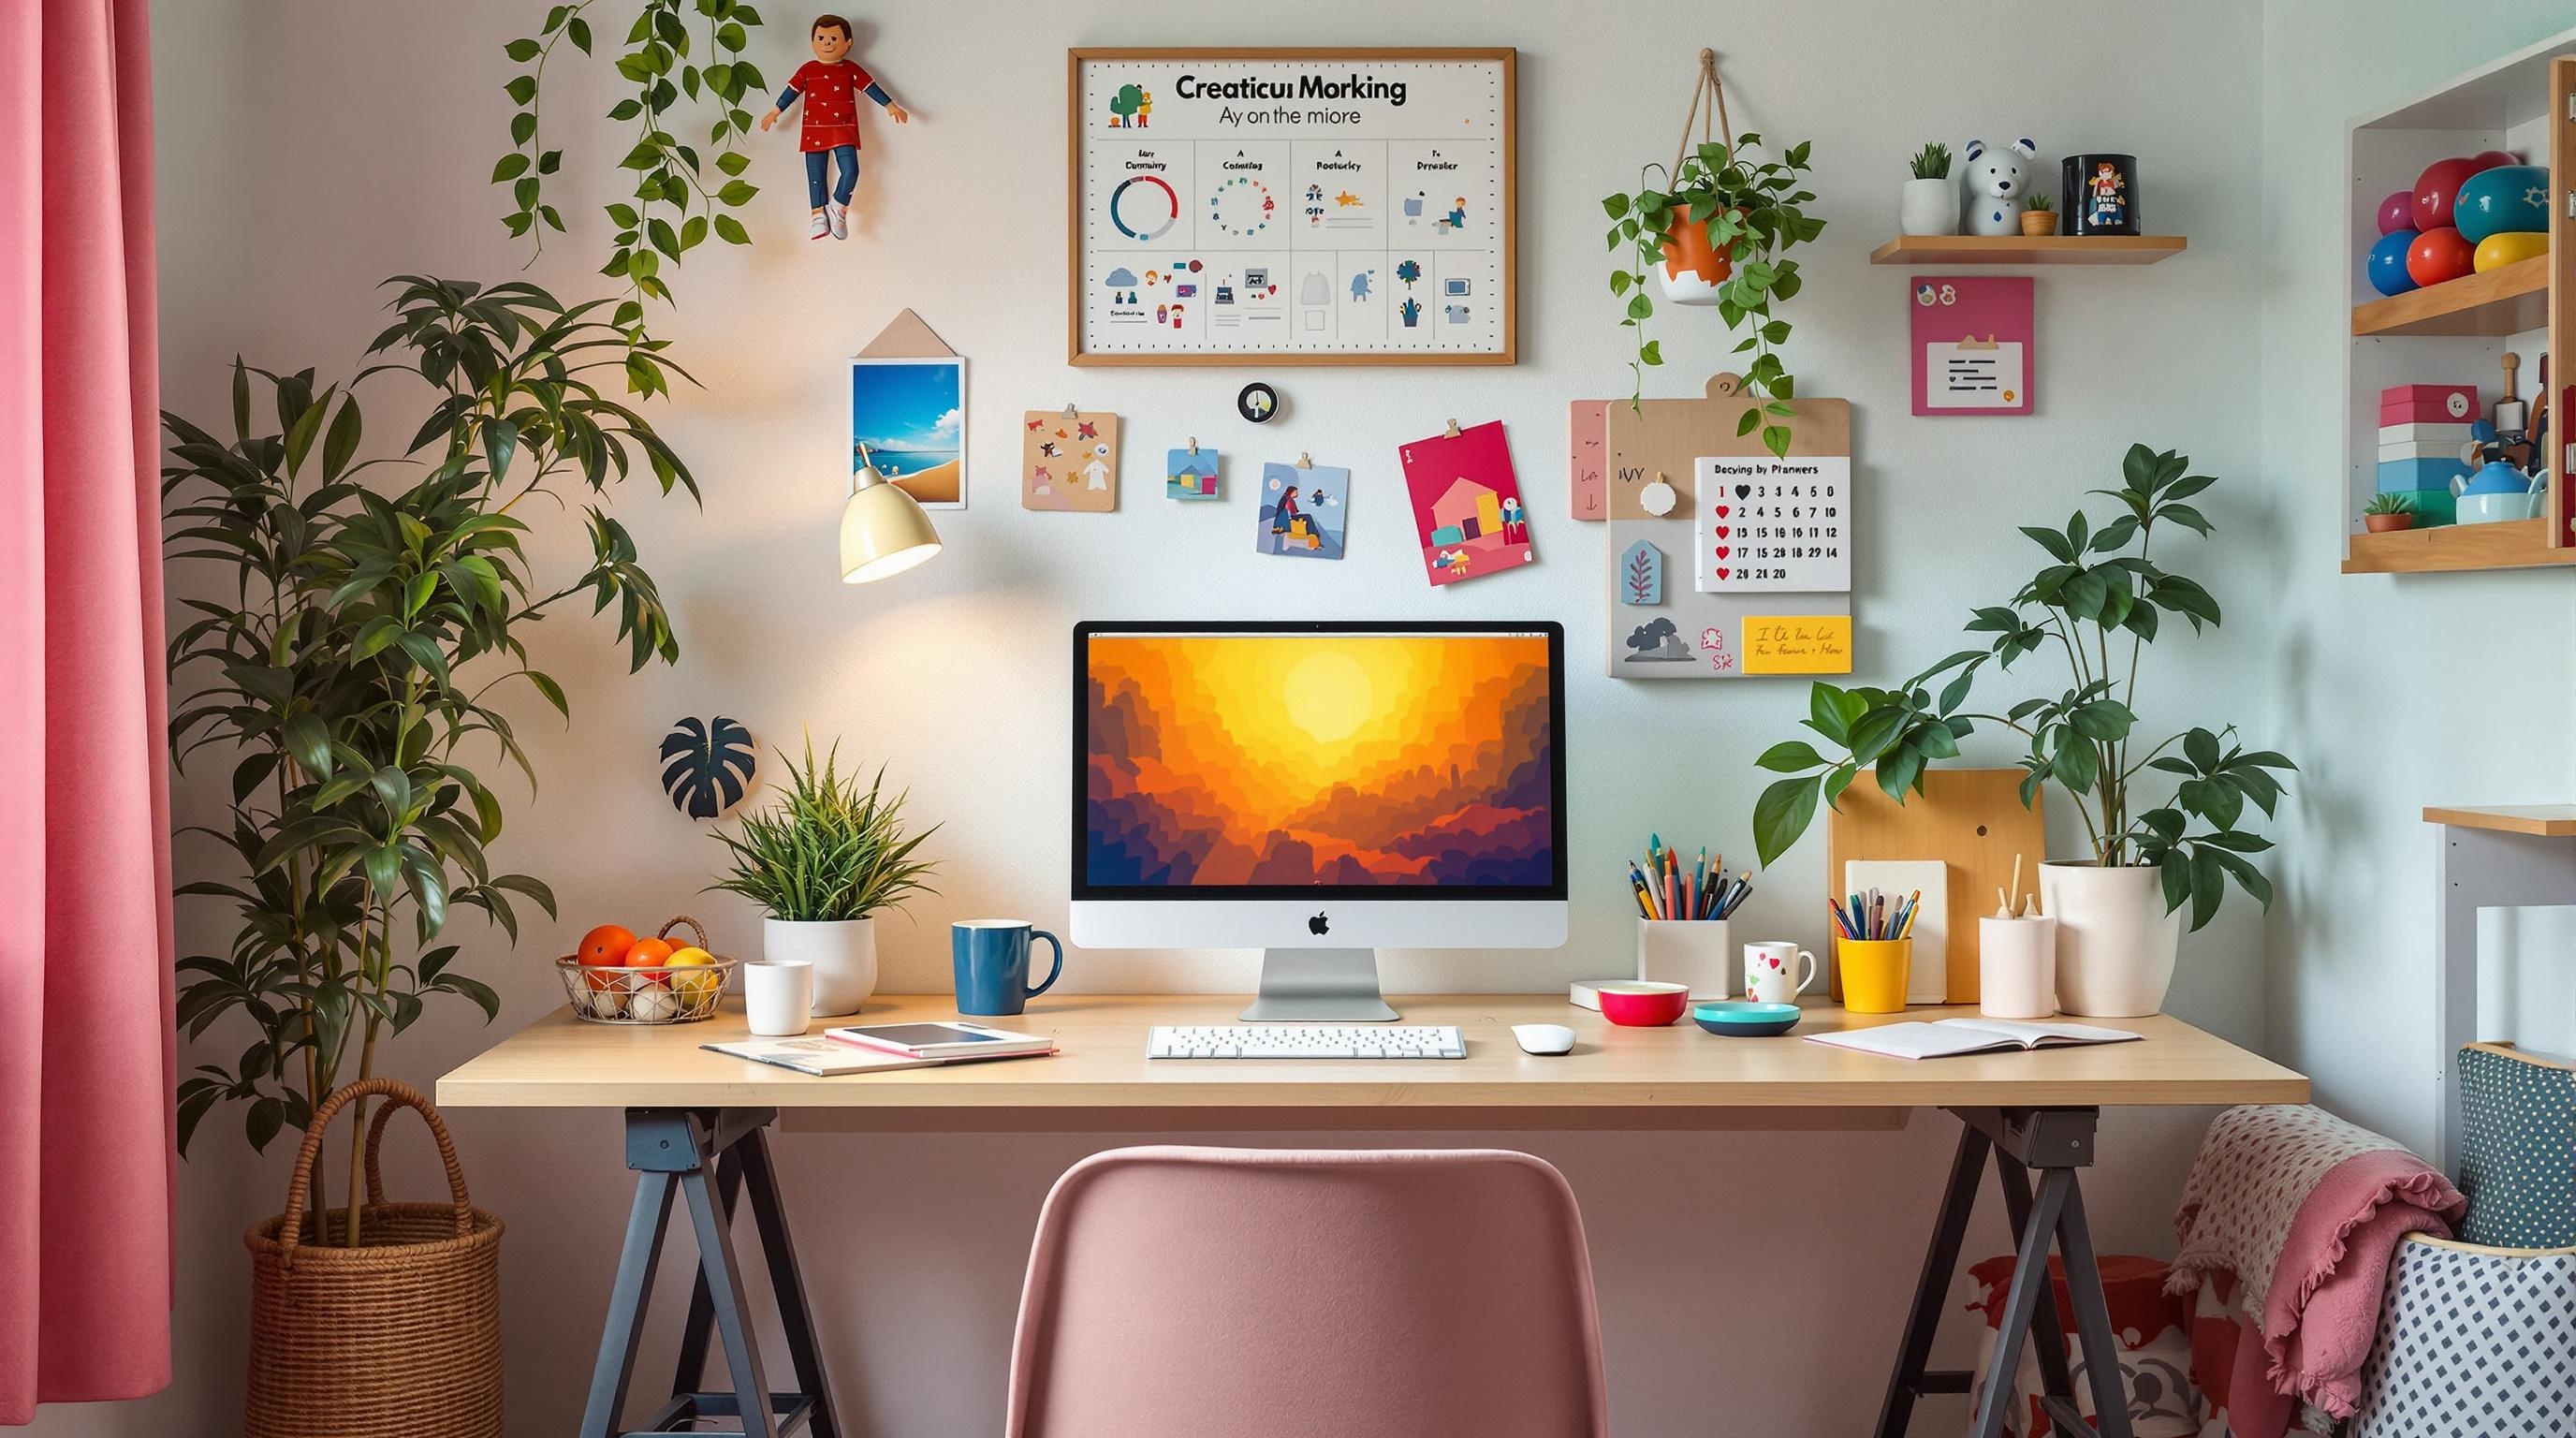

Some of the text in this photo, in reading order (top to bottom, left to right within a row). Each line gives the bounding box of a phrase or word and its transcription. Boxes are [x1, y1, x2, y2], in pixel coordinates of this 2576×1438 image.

[1299, 74, 1407, 107] Morking
[1219, 106, 1361, 127] Ay on the miore
[1756, 464, 1767, 475] by
[1738, 506, 1746, 518] 2
[1757, 506, 1764, 518] 4
[1774, 506, 1781, 518] 5
[1793, 506, 1800, 518] 6
[1809, 506, 1817, 518] 7
[1737, 548, 1749, 559] 17
